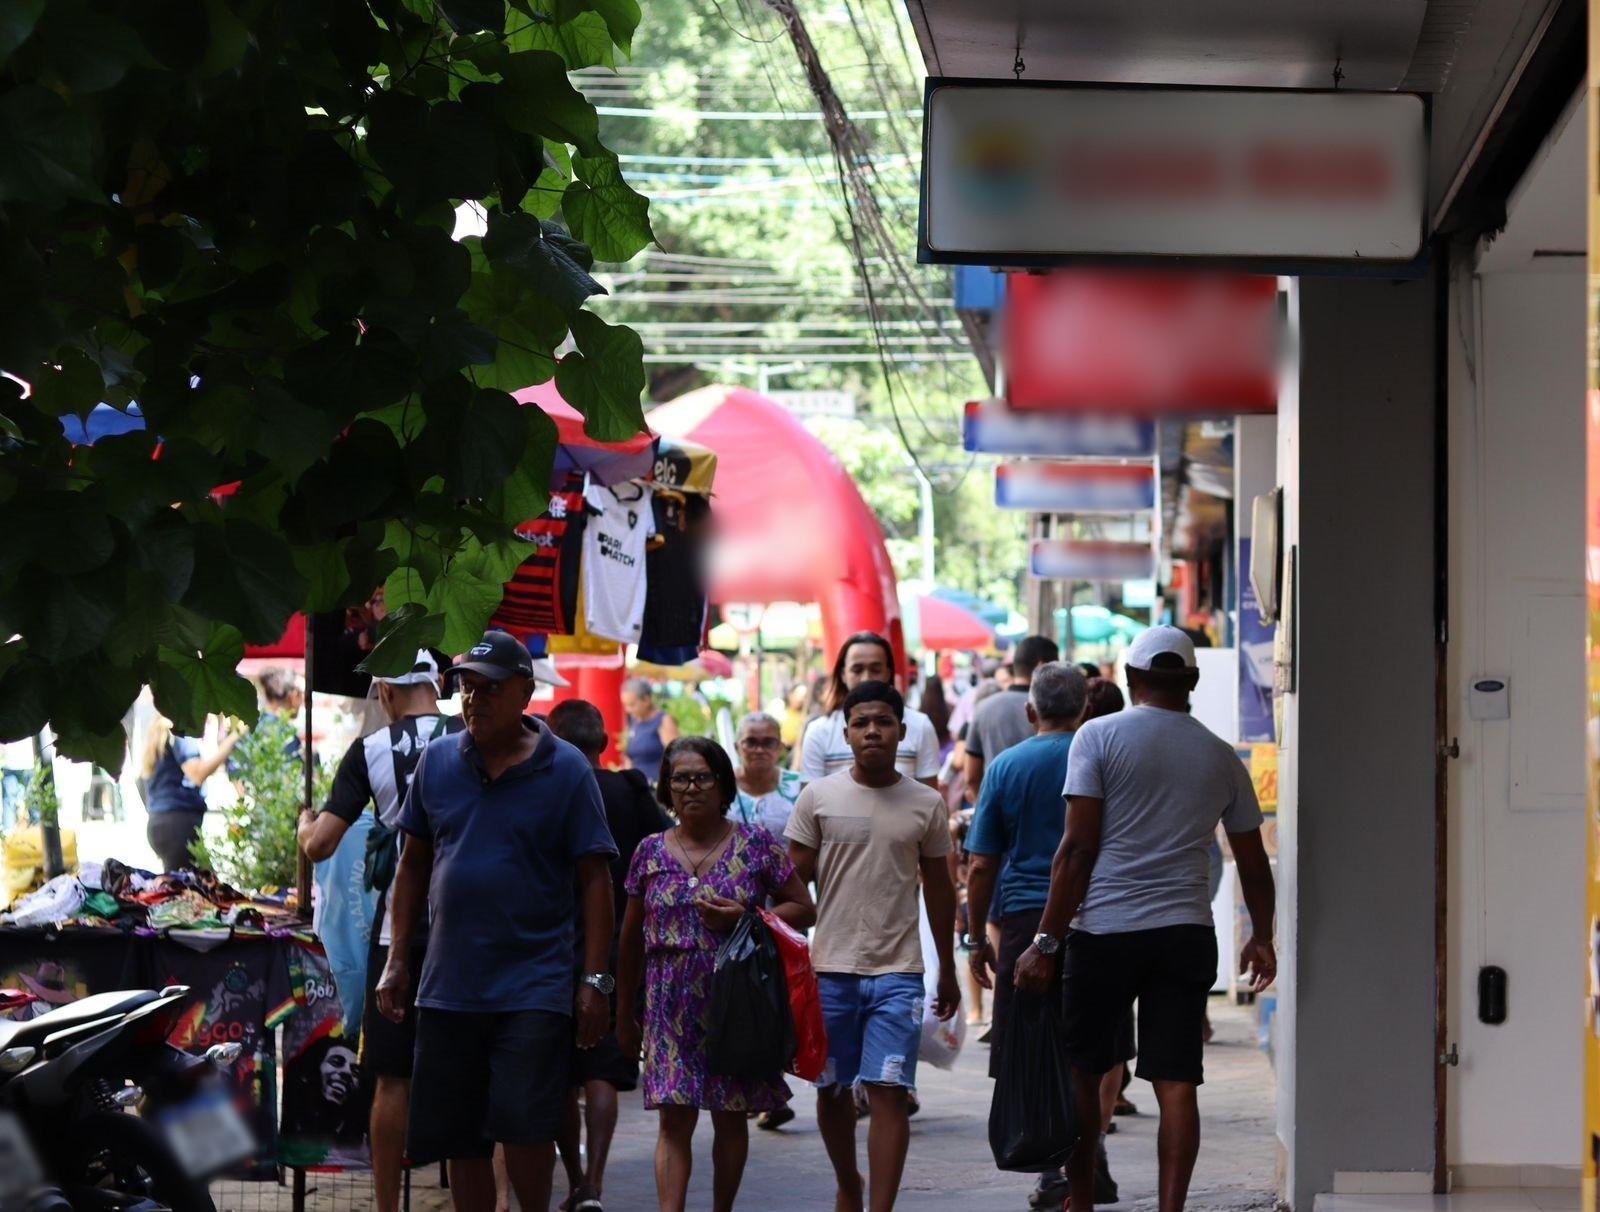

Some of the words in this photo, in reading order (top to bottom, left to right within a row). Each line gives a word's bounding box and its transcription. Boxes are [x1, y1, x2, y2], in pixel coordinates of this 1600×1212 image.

[599, 532, 622, 550] PARI
[603, 546, 635, 567] MATCH
[304, 978, 335, 1007] Bob
